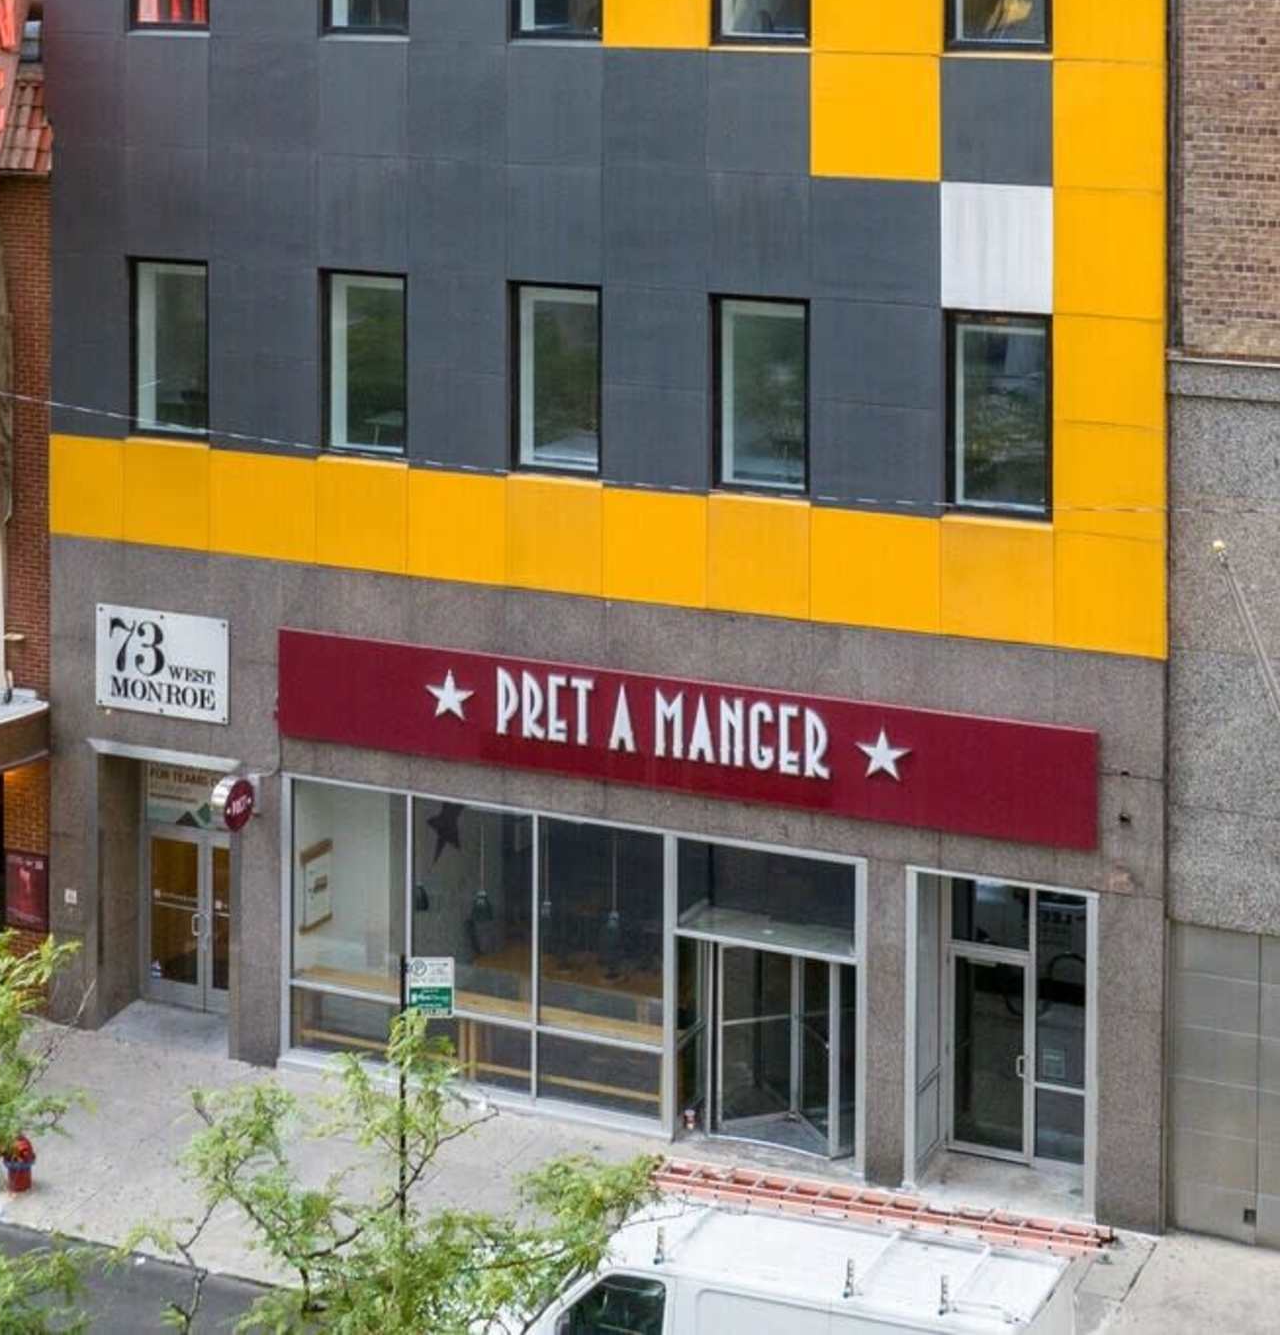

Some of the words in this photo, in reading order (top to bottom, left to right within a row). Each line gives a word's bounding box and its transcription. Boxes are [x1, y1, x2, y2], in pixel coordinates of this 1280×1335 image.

[108, 616, 165, 677] 73
[168, 664, 216, 684] WEST
[110, 674, 216, 712] MONROE
[495, 666, 594, 746] PRET
[608, 683, 637, 753] A
[654, 687, 830, 780] MANGER
